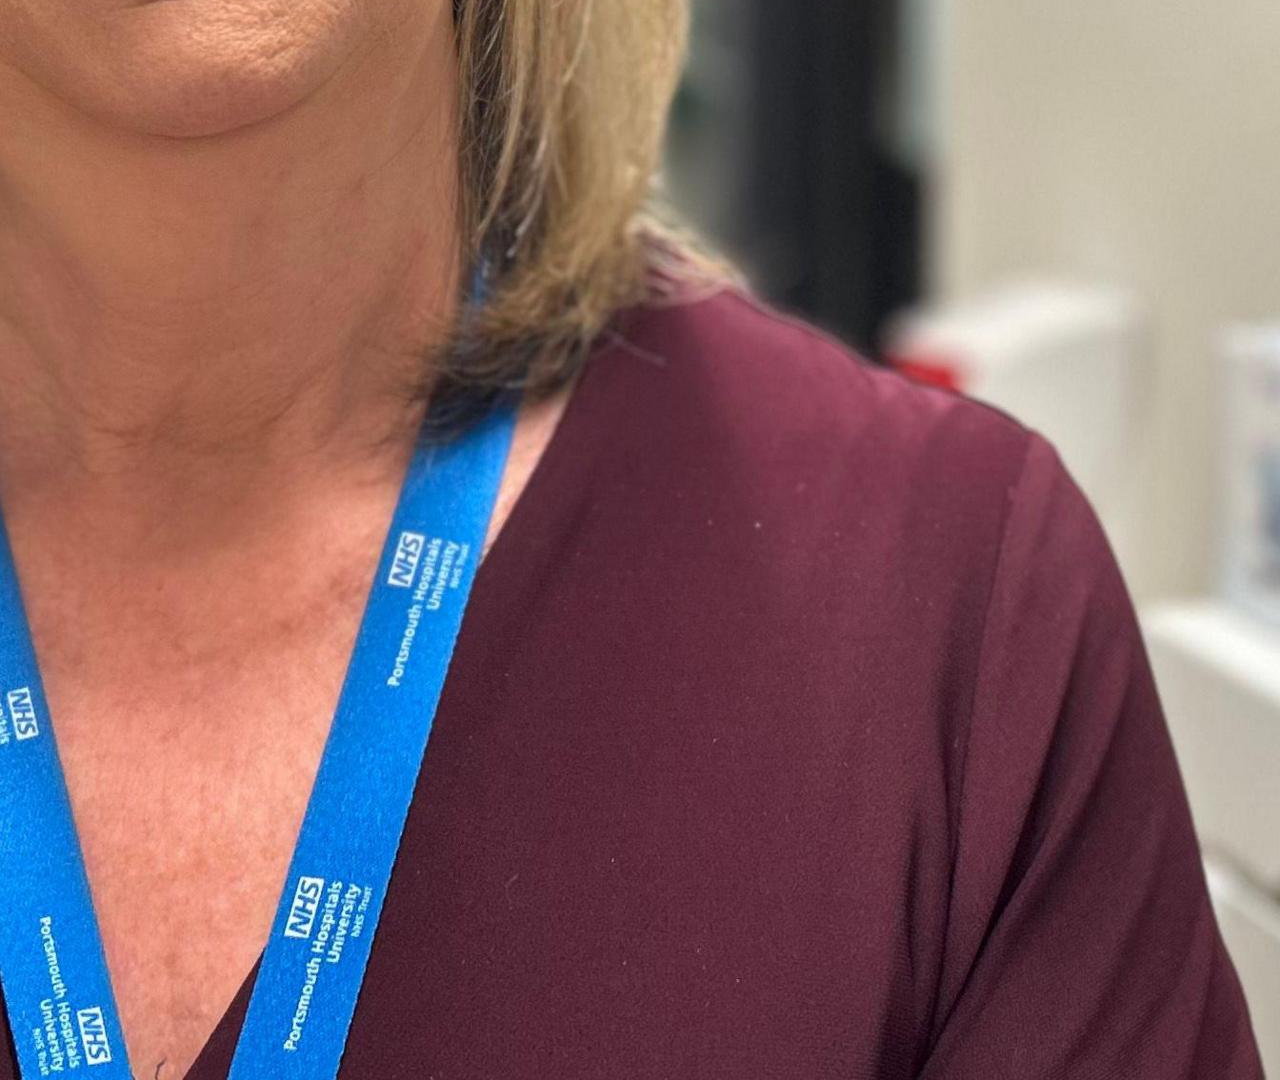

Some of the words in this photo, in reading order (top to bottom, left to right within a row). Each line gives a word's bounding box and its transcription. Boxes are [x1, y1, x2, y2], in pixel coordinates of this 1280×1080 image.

[390, 533, 422, 586] NHS
[426, 540, 460, 610] University
[387, 604, 422, 687] Portsmouth
[412, 537, 442, 601] Hospitals
[9, 689, 37, 738] NHS
[287, 878, 321, 936] NHS
[326, 883, 361, 963] University
[351, 914, 365, 938] NHS
[40, 916, 67, 999] Portsmouth
[57, 1001, 81, 1068] Hospitals
[283, 957, 321, 1051] Portsmouth
[311, 881, 343, 953] Hospitals
[40, 999, 64, 1072] University
[79, 1009, 110, 1062] NHS
